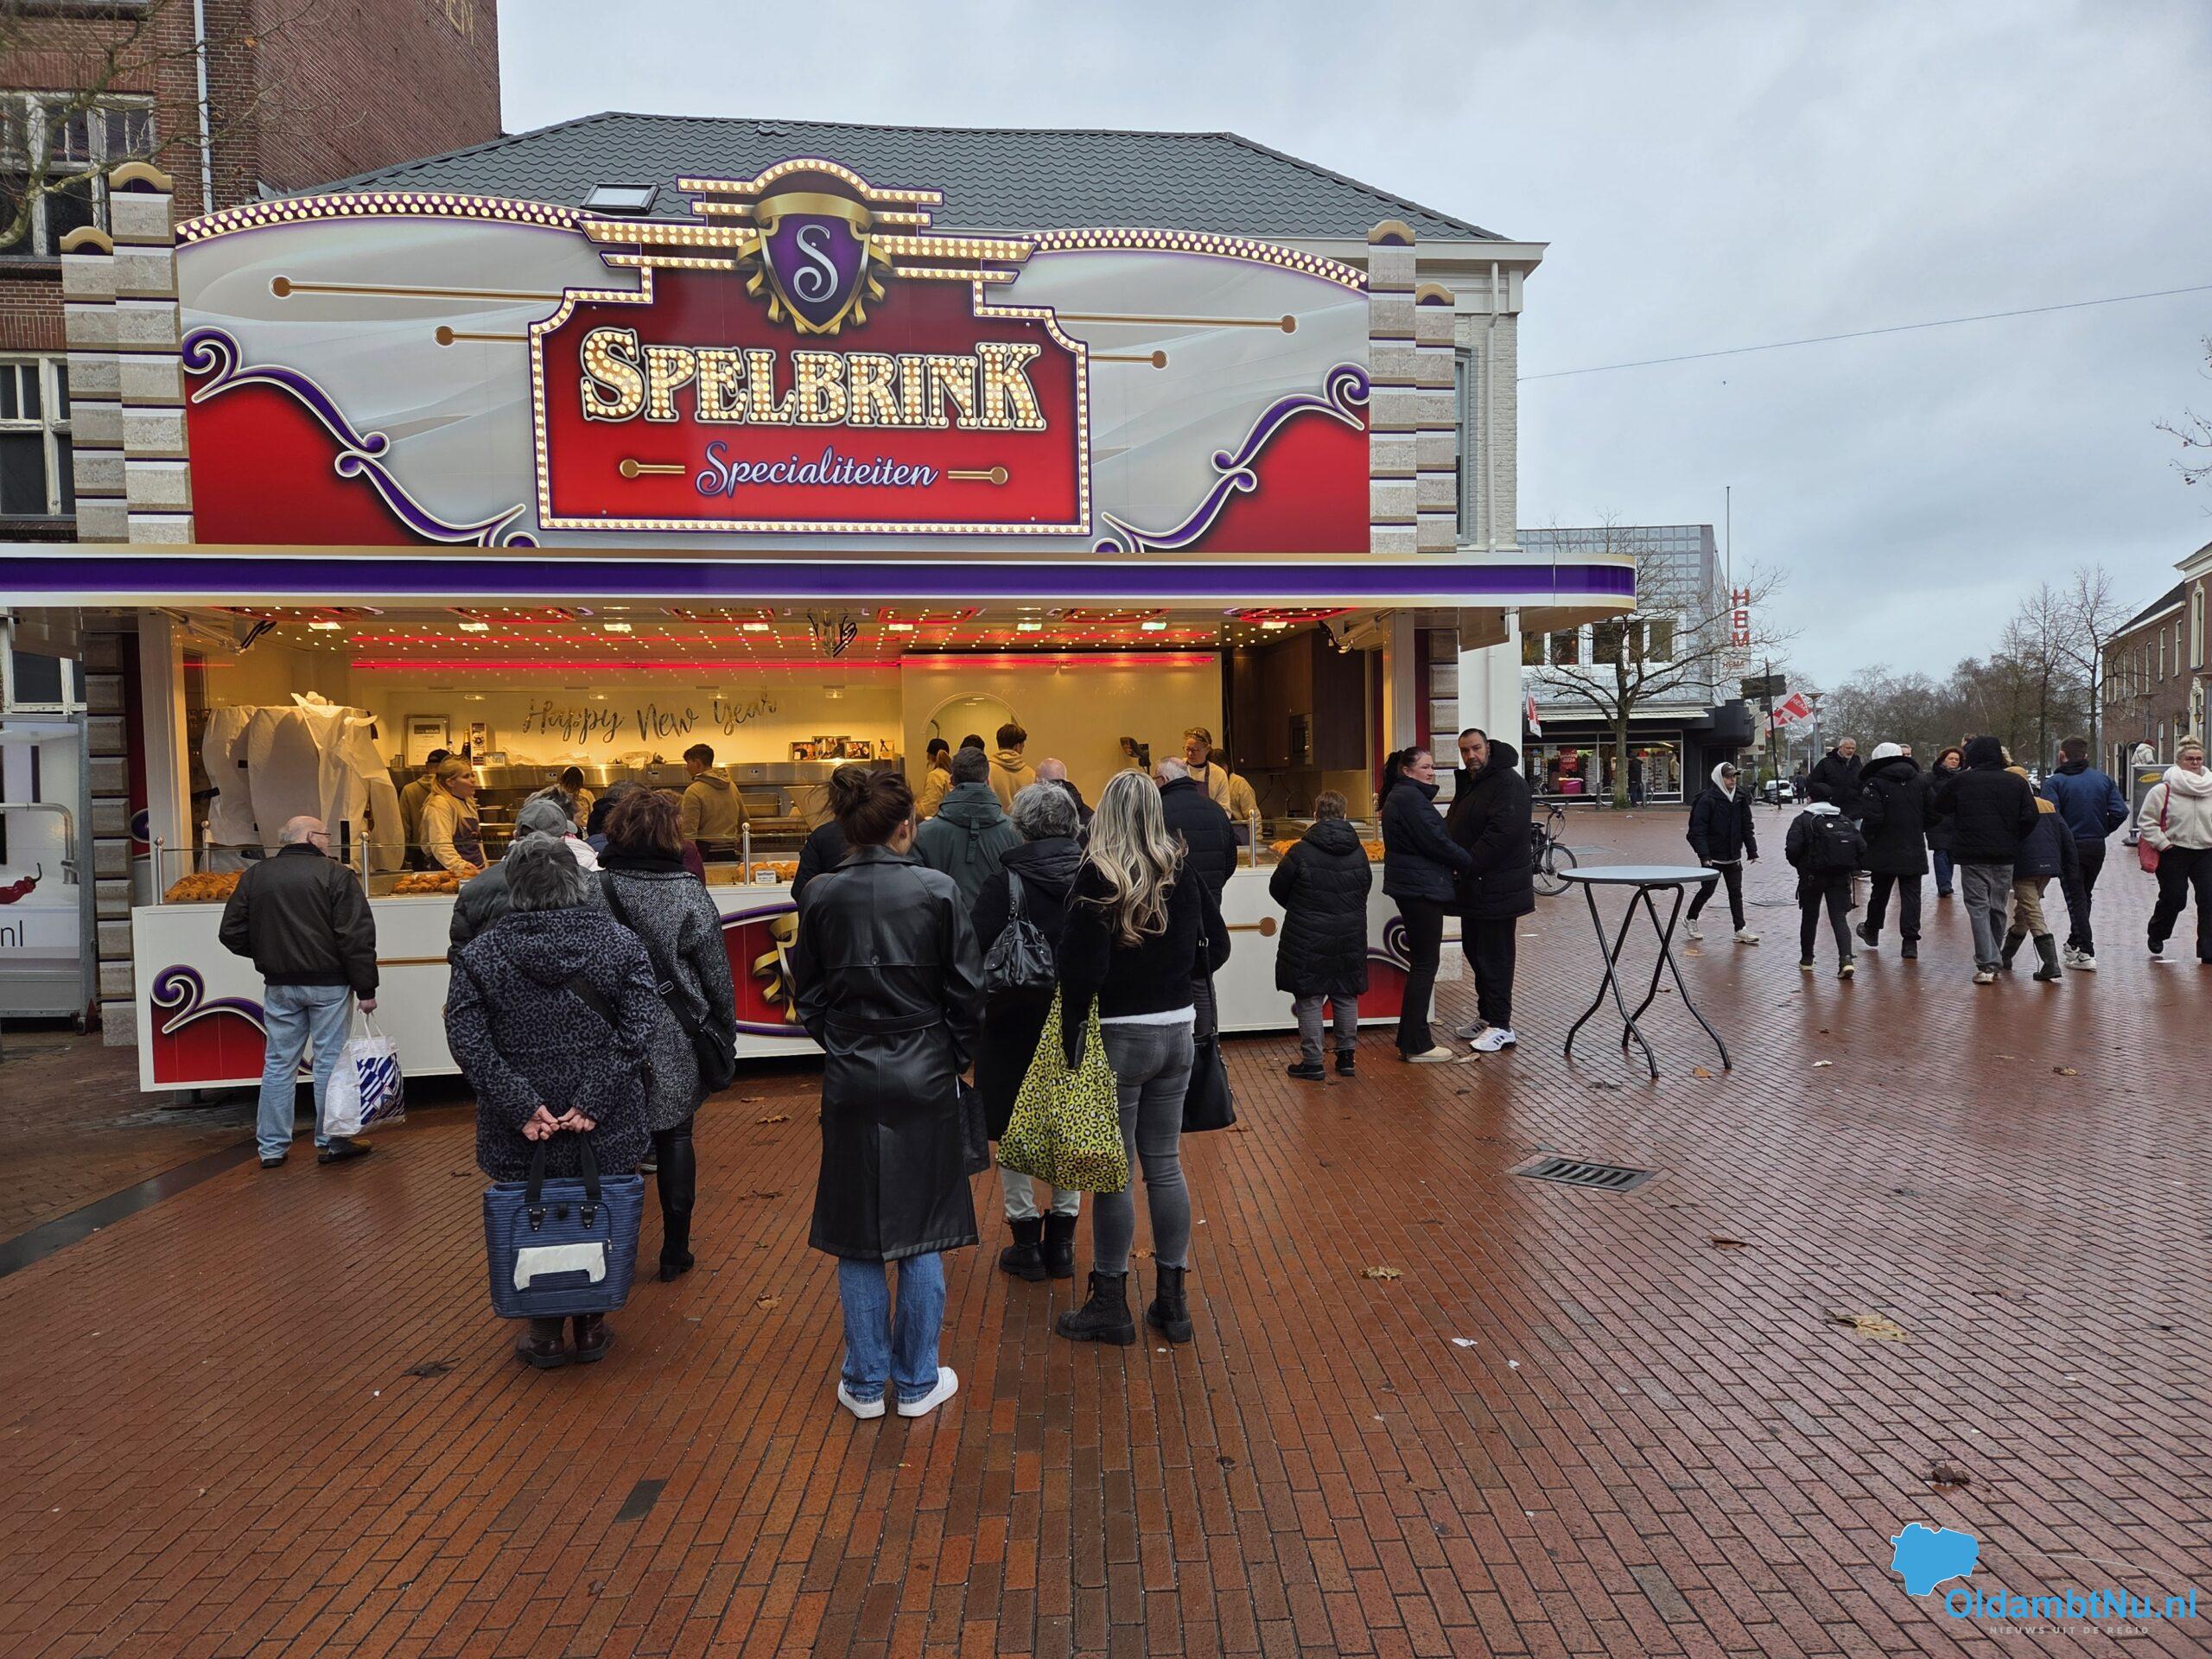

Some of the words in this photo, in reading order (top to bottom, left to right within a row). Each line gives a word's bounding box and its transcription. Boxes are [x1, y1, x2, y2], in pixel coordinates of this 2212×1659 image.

[580, 327, 1047, 431] SPELBRINK
[695, 441, 939, 498] Specialiteiten
[523, 698, 626, 746] Happy
[637, 702, 700, 741] New
[713, 691, 779, 736] Year
[1789, 697, 1810, 714] HEMA
